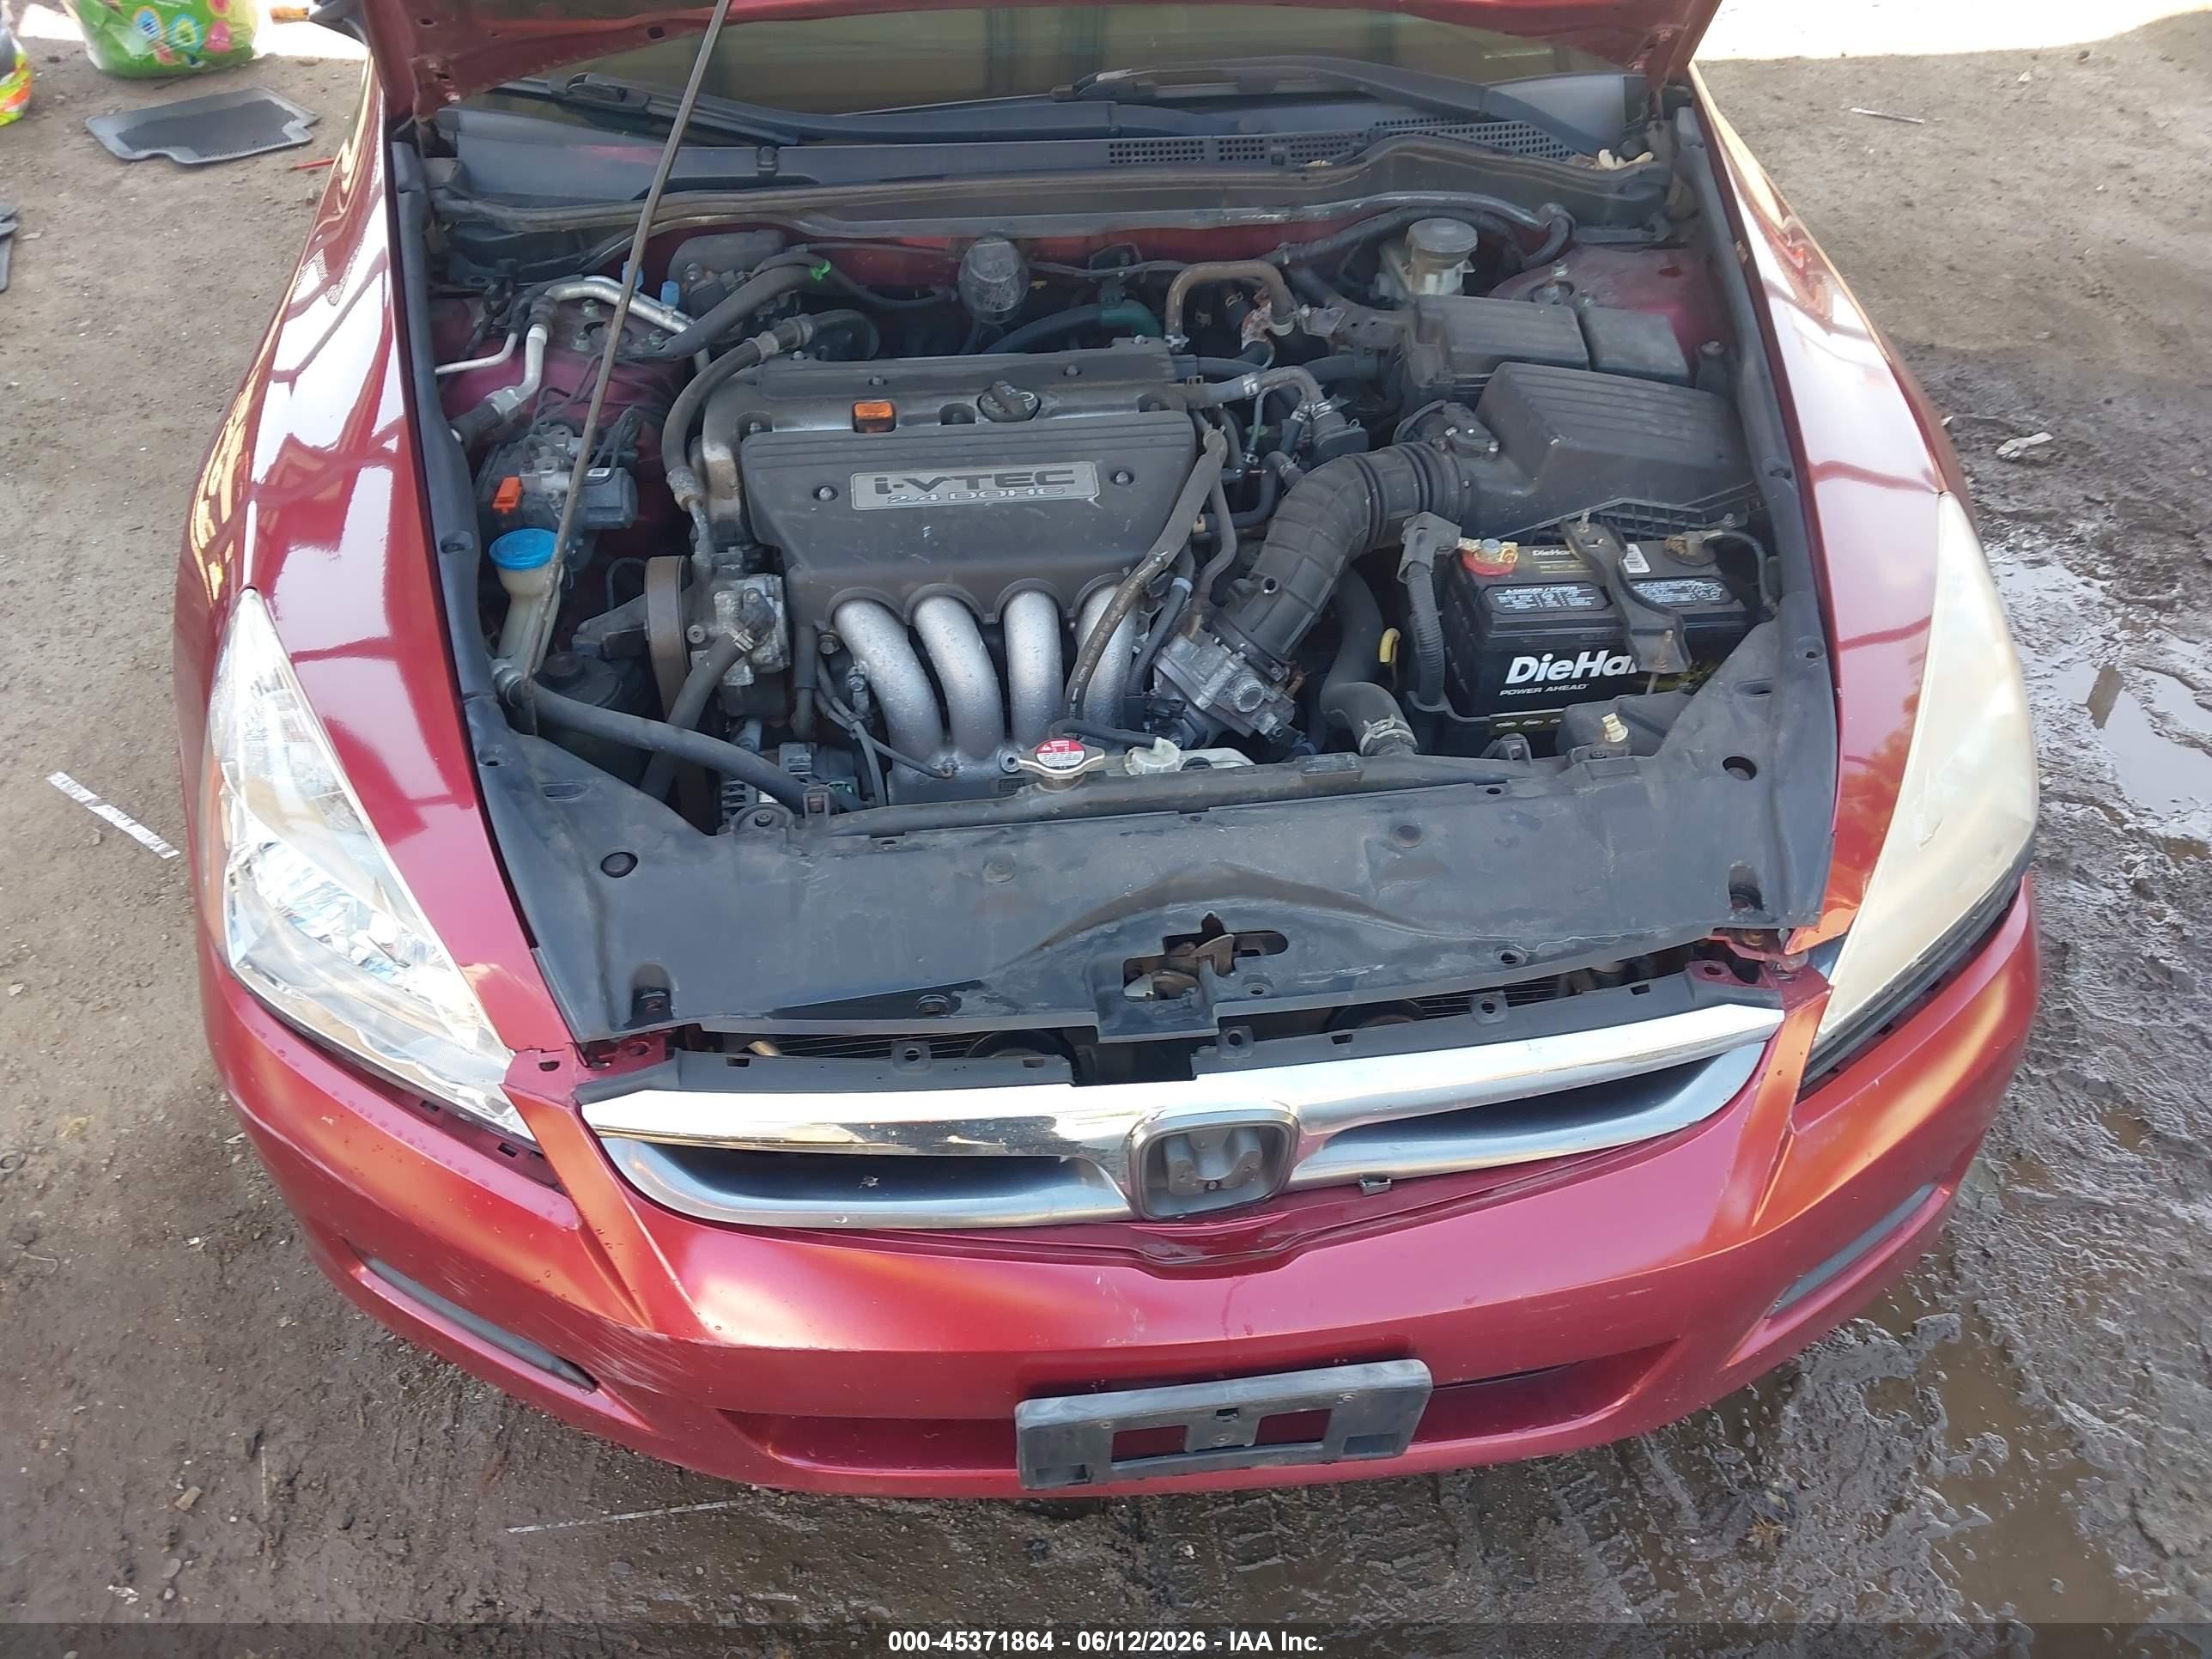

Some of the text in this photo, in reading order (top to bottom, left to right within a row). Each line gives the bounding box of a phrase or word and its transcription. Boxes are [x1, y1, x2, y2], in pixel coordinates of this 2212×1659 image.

[874, 469, 1075, 495] i-VTEC
[887, 486, 1066, 504] 2.4 DOHC
[1498, 687, 1542, 696] POWER
